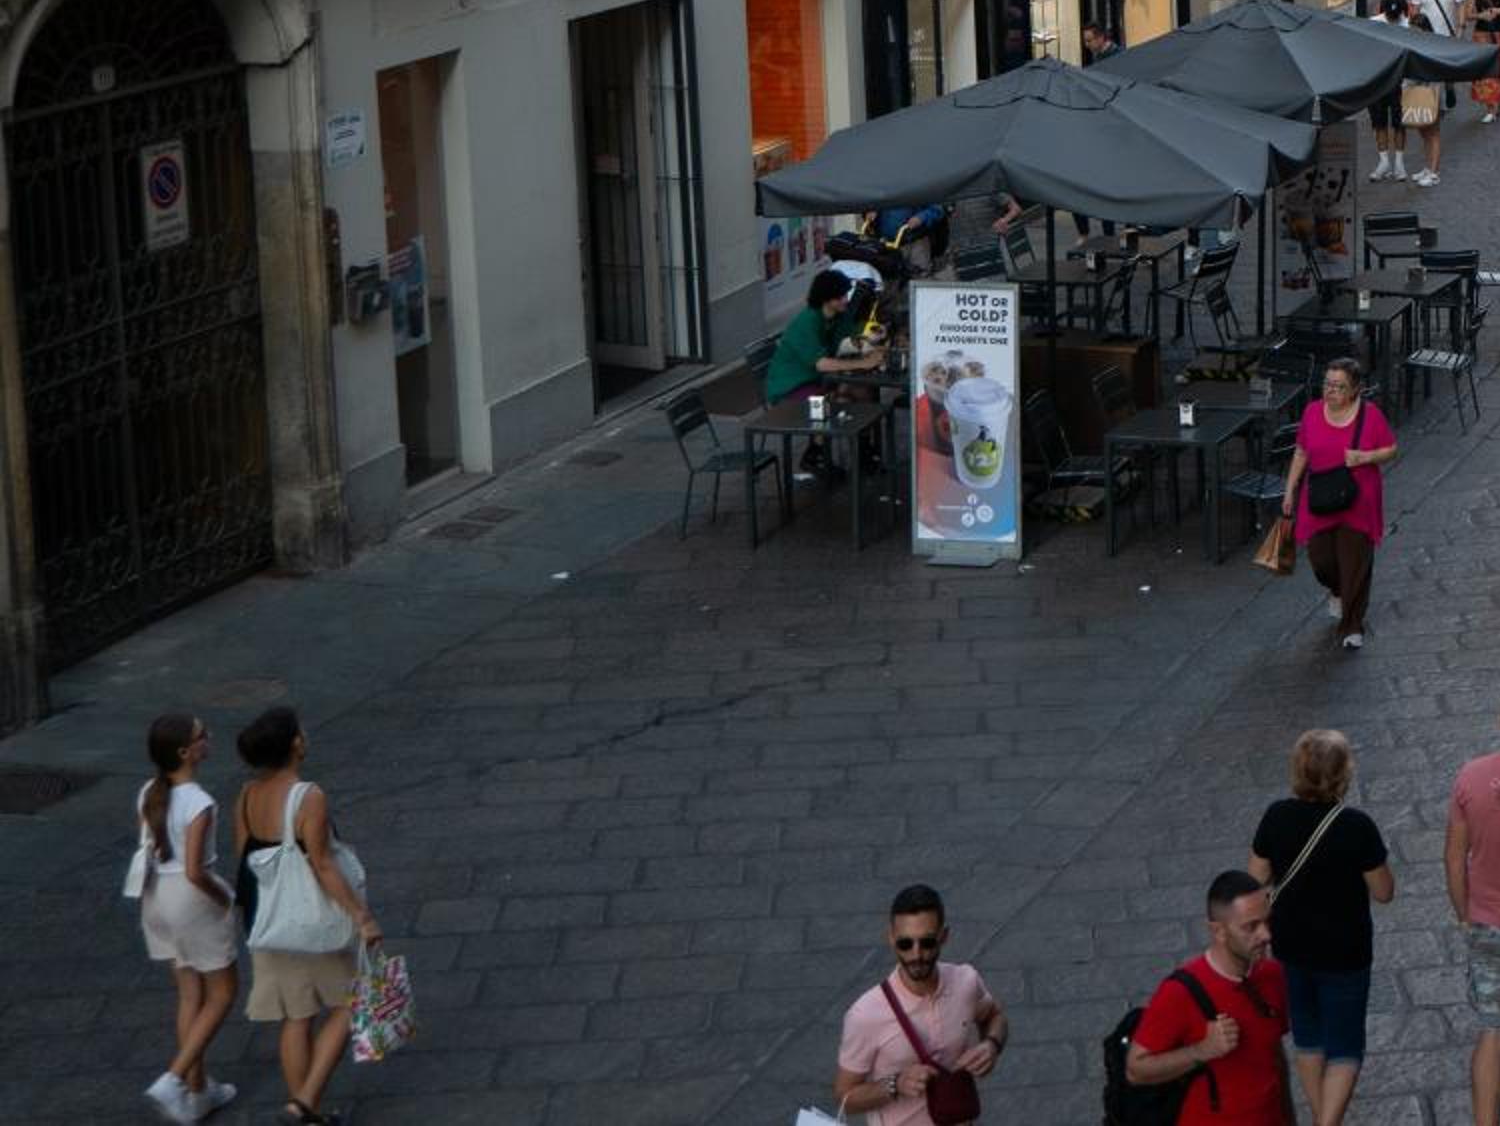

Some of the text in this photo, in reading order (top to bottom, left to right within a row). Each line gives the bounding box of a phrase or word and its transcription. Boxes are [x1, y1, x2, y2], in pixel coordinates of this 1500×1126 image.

[956, 293, 1008, 307] HOT OR
[958, 309, 1008, 322] COLD?
[980, 325, 1007, 334] YOUR
[989, 337, 1008, 346] ONE
